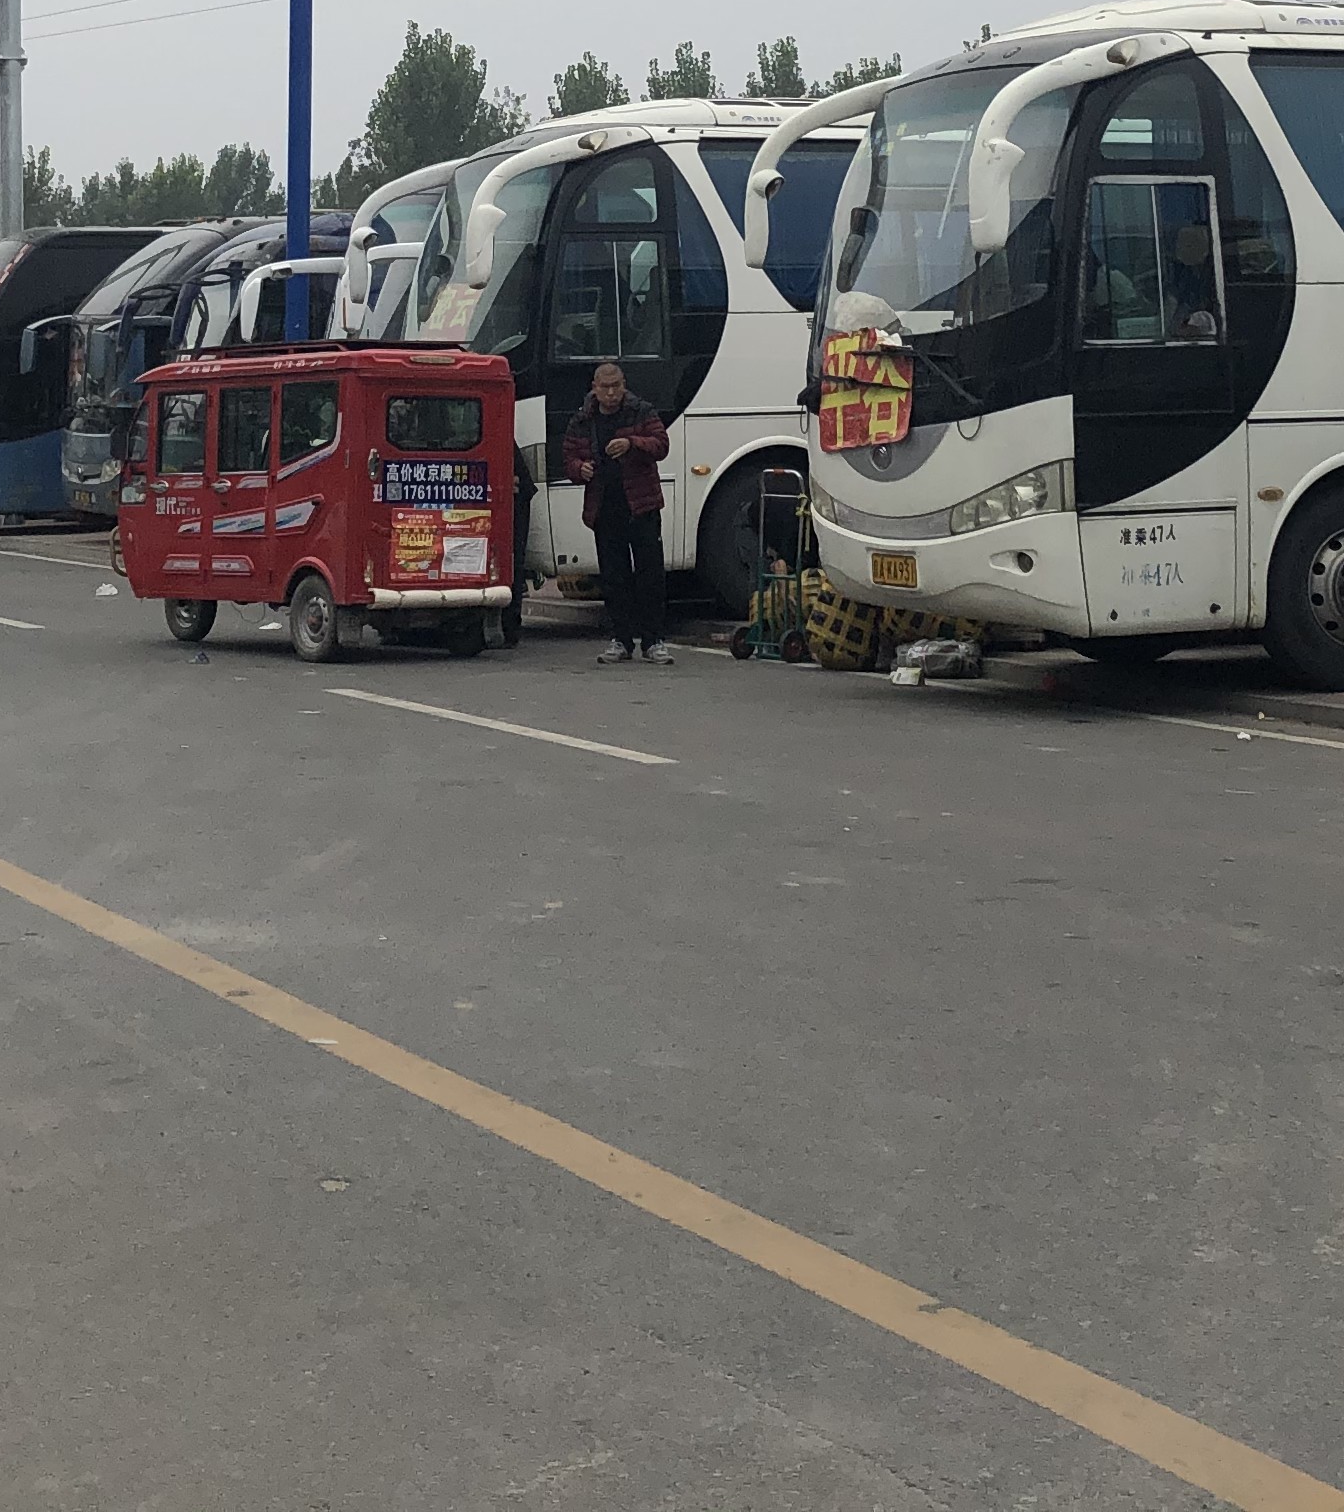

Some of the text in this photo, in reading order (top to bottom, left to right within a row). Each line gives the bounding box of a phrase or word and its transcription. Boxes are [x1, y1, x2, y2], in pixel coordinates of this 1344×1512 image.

[820, 334, 911, 448] 平谷
[386, 463, 453, 482] 高价收京牌
[403, 484, 484, 500] 17611110832
[1119, 523, 1177, 546] 准乘47人
